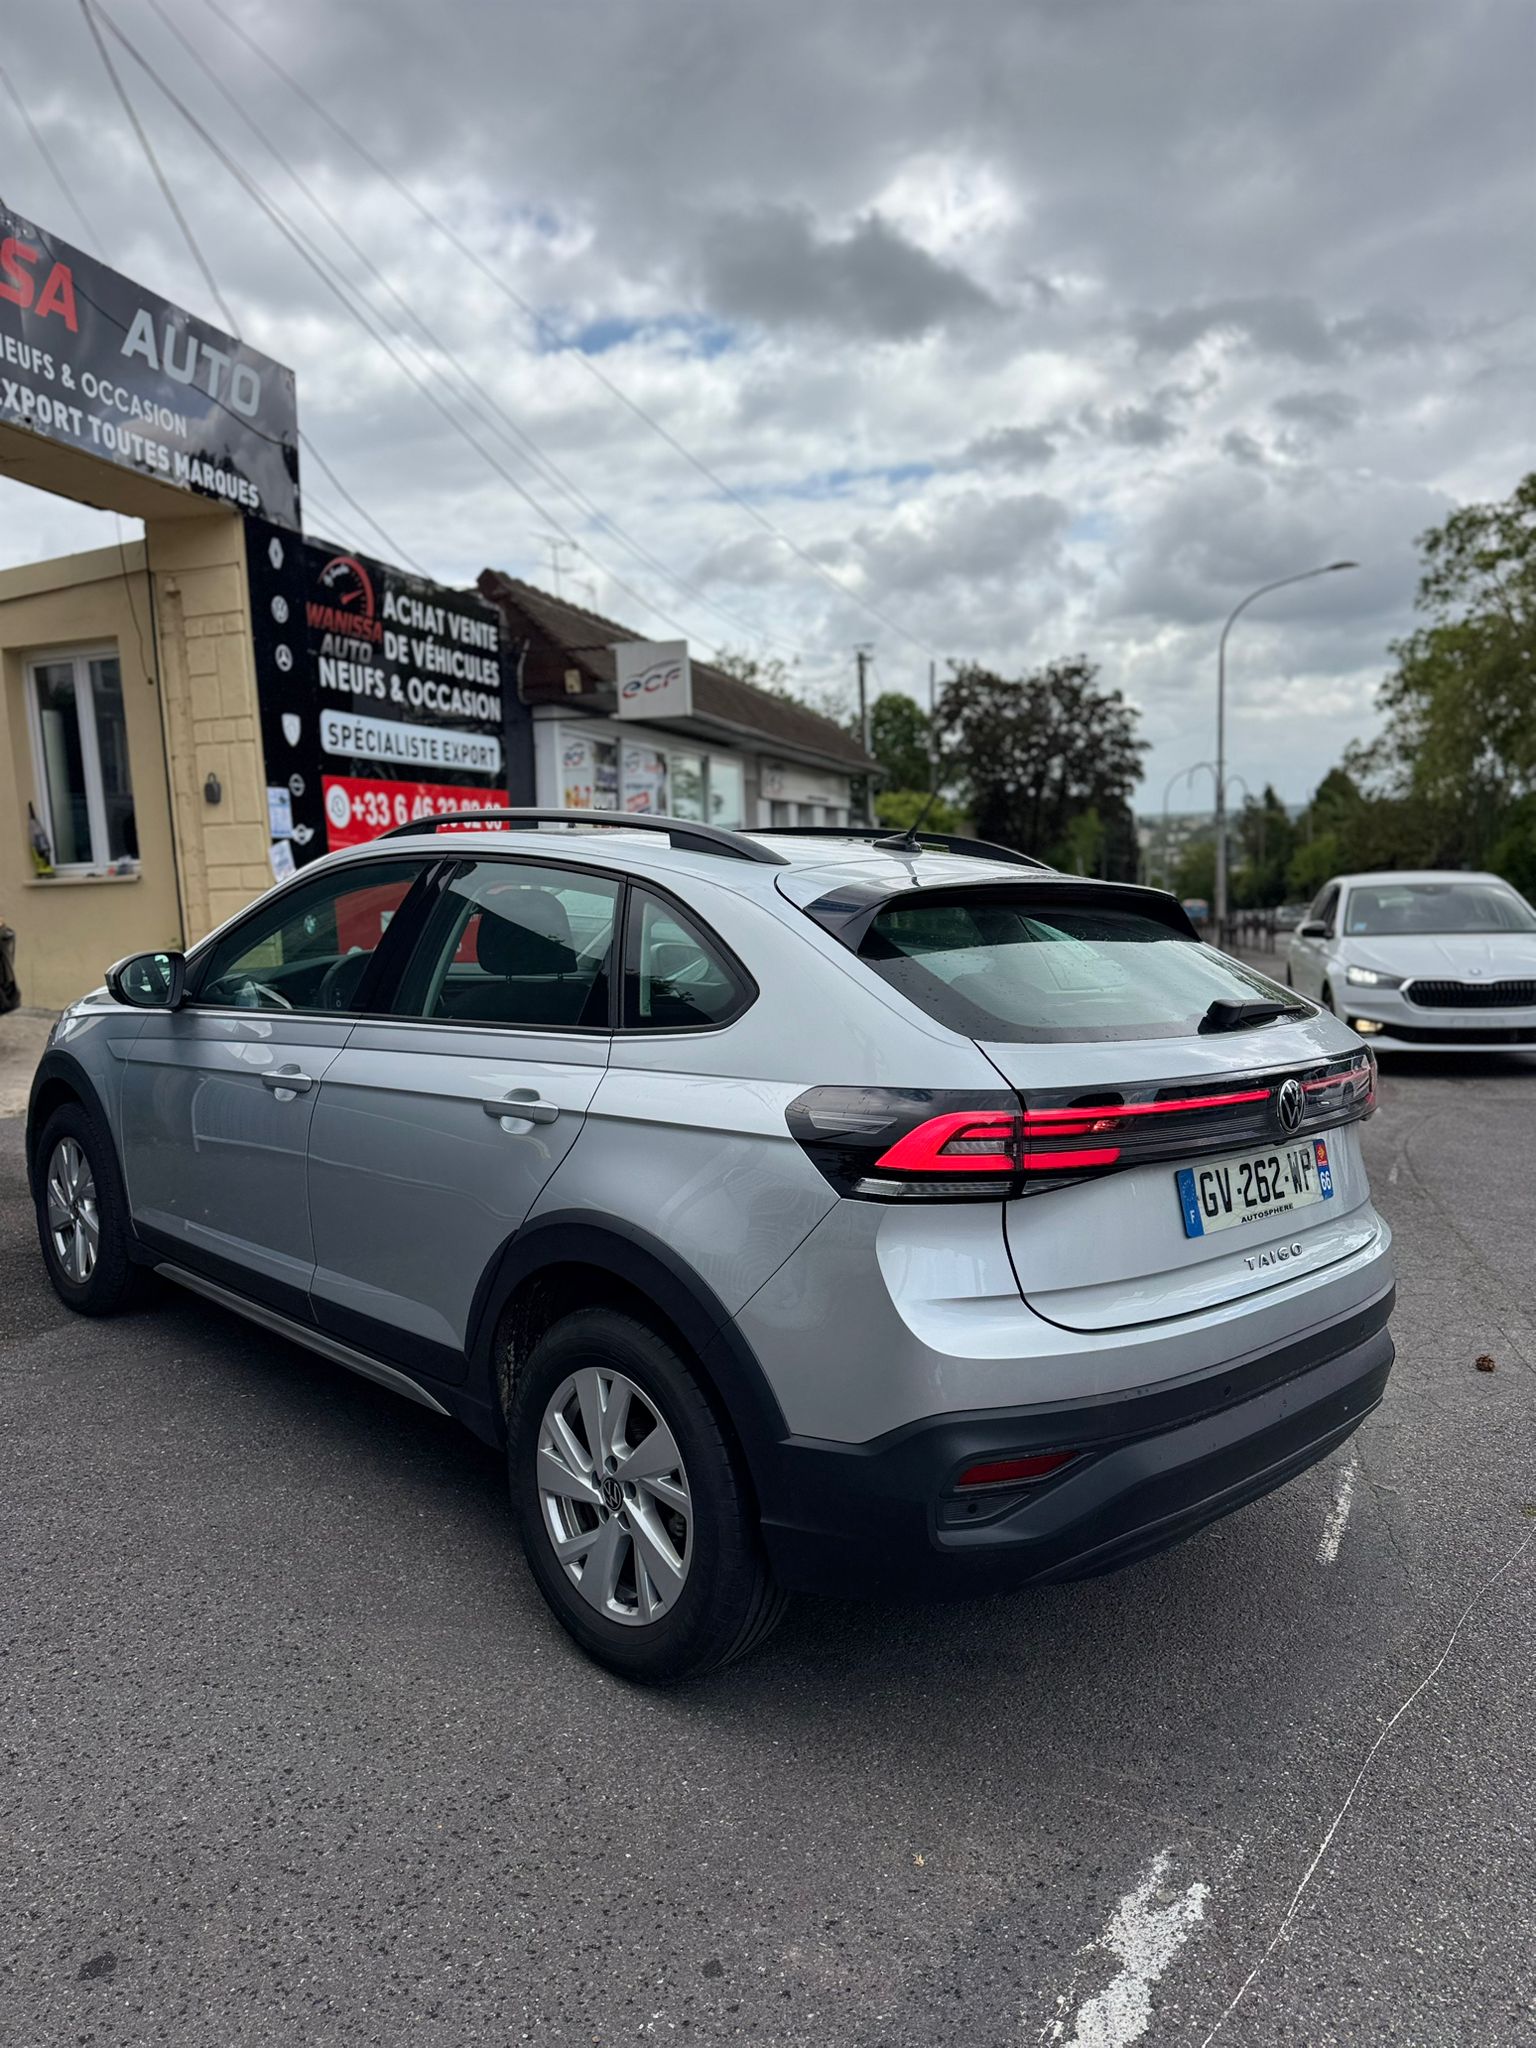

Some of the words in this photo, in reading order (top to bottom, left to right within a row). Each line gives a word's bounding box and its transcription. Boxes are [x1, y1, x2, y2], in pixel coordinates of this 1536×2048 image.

[121, 308, 262, 417] AUTO
[62, 363, 76, 390] &
[81, 372, 187, 438] OCCASION
[0, 378, 82, 437] XPORT
[88, 415, 169, 471] TOUTES
[174, 451, 259, 508] MARQUES
[305, 600, 383, 643] WANISSA
[382, 591, 447, 635] ACHAT
[448, 612, 499, 652] VENTE
[320, 633, 373, 663] AUTO
[383, 630, 410, 665] DE
[412, 638, 500, 688] VÉHICULES
[318, 656, 386, 700] NEUFS
[390, 674, 404, 702] &
[408, 681, 501, 722] OCCASION
[328, 720, 438, 762] SPÉCIALISTE
[443, 740, 496, 768] EXPORT
[352, 791, 391, 827] +33
[394, 793, 408, 826] 6
[1320, 1170, 1332, 1191] 66
[1189, 1209, 1196, 1224] F
[1241, 1203, 1294, 1224] AUTOSPHERE
[1244, 1242, 1303, 1271] TAIGO
